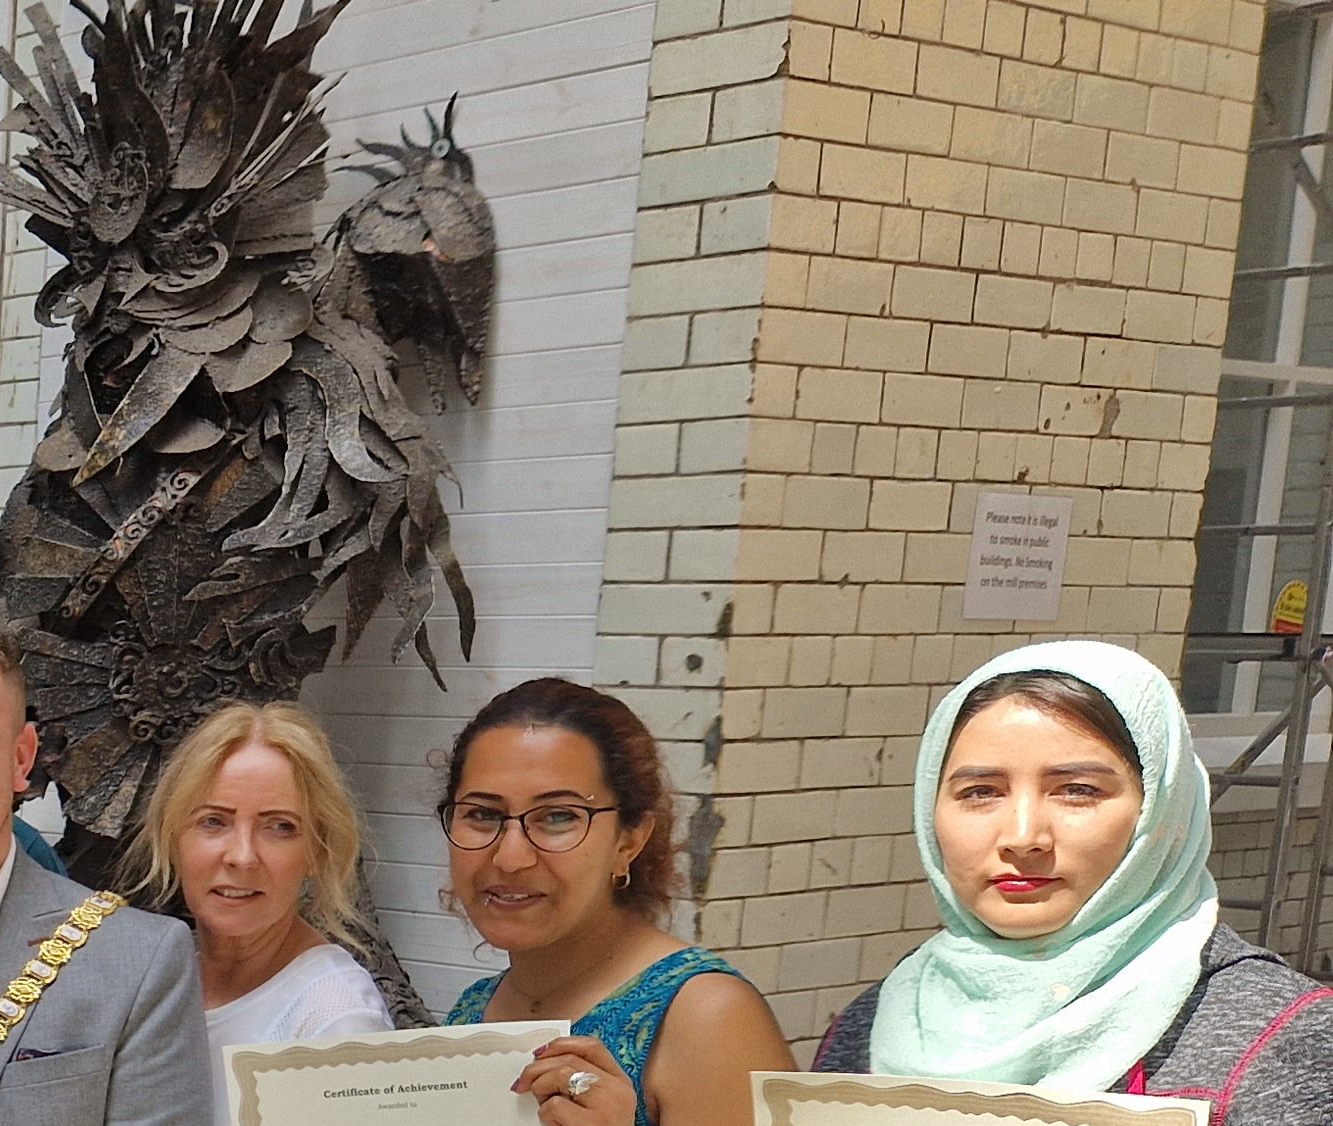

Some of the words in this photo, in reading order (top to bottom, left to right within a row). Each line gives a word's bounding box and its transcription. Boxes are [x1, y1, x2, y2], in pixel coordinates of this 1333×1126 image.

[986, 511, 1009, 524] Please
[1011, 516, 1026, 525] note
[1039, 514, 1059, 529] illegal
[990, 535, 998, 545] to
[999, 535, 1022, 546] smoke
[1029, 536, 1049, 549] public
[1015, 557, 1025, 567] No
[980, 578, 990, 587] on
[991, 576, 1004, 588] the
[324, 1087, 380, 1098] Certificate
[383, 1085, 395, 1094] of
[397, 1080, 468, 1093] Achievement
